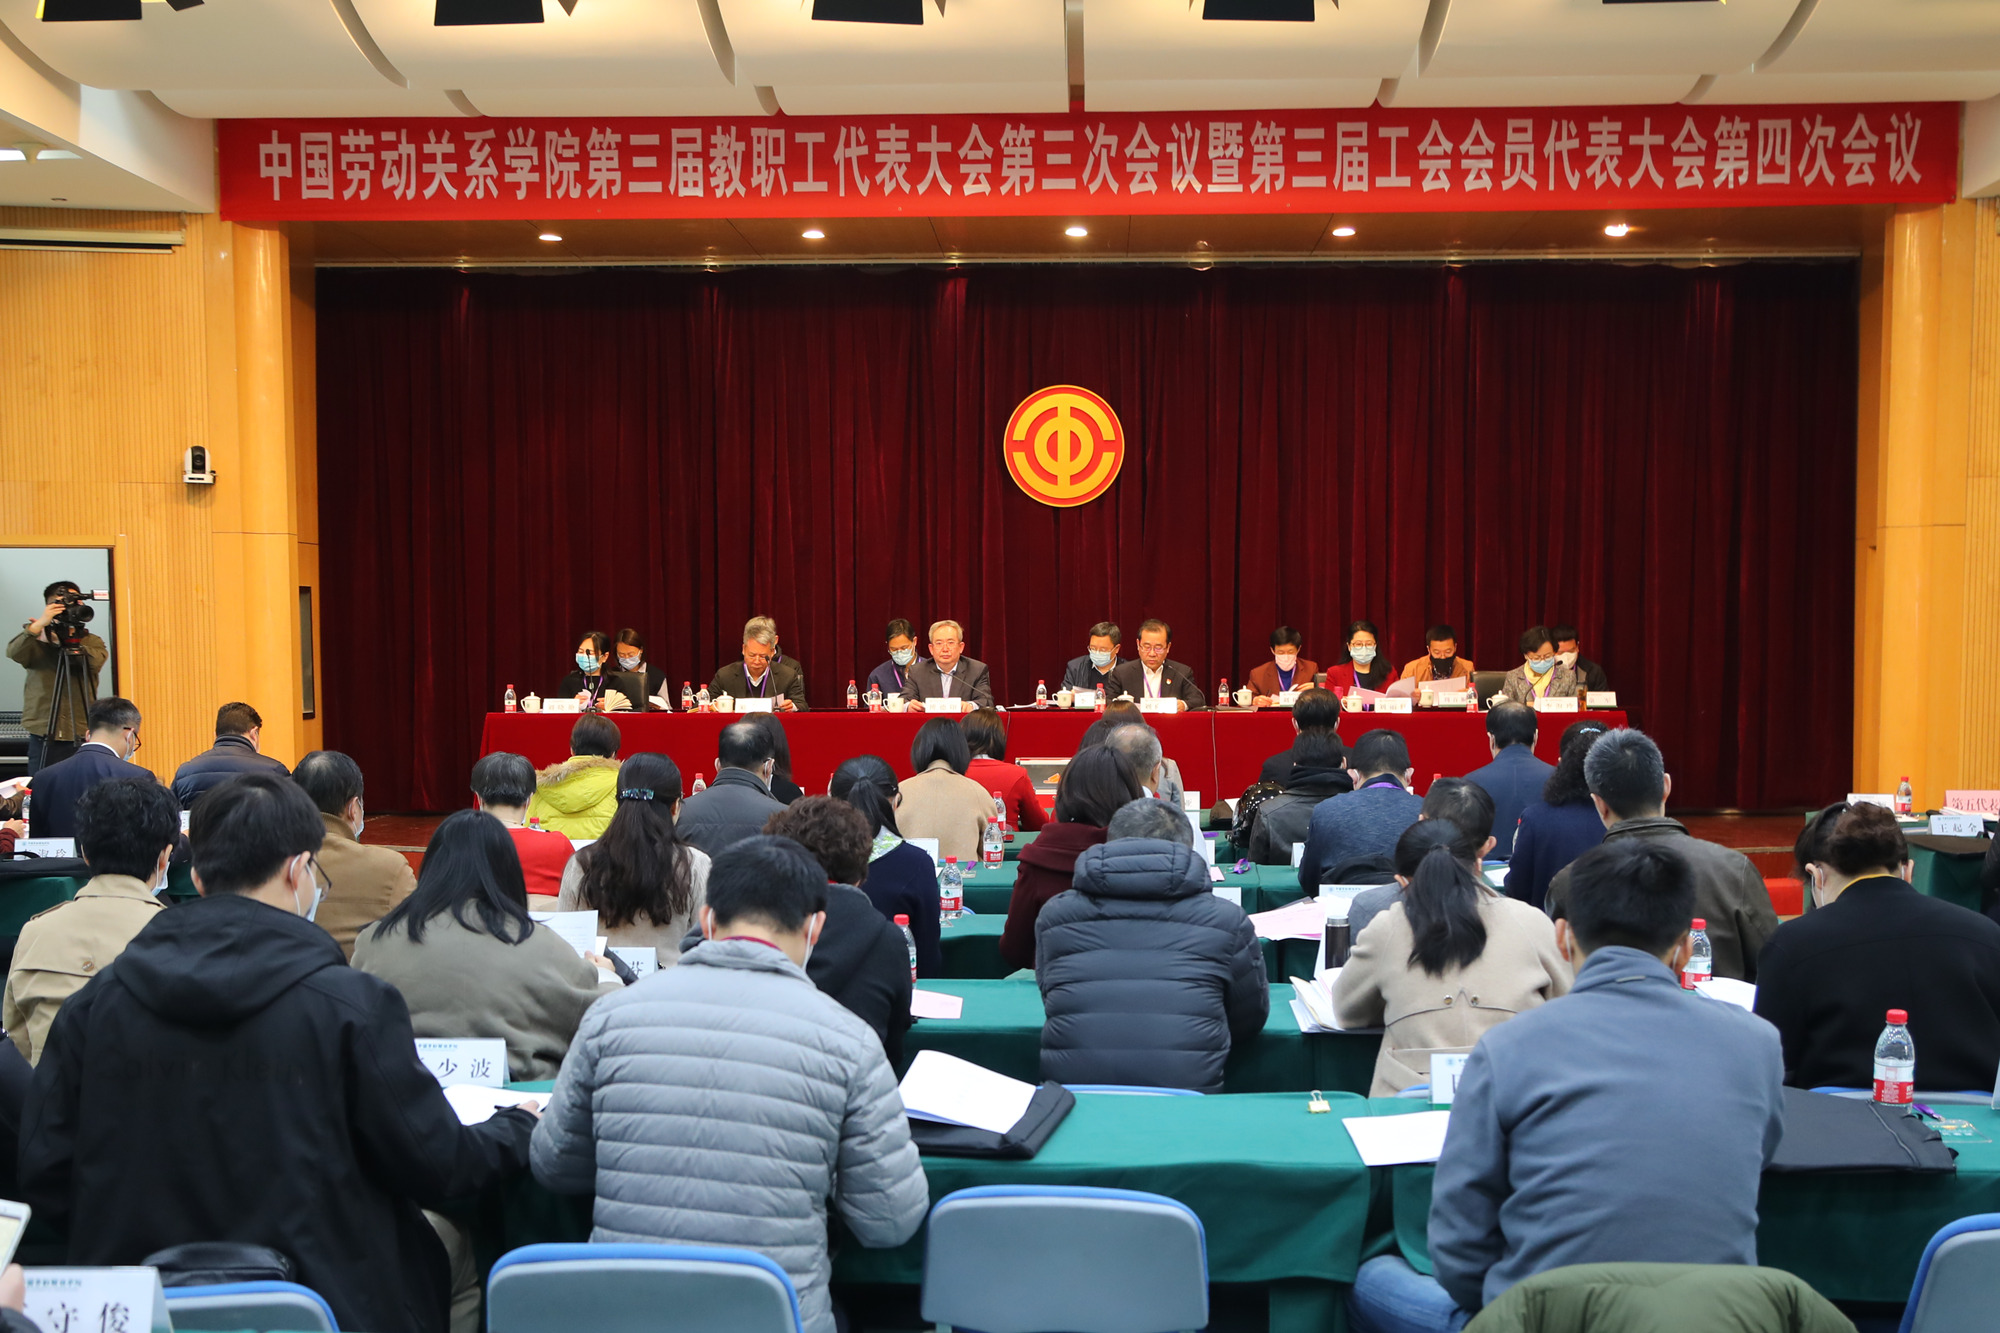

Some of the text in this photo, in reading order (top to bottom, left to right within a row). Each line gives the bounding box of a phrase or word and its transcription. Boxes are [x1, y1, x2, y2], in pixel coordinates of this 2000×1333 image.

[257, 111, 1923, 203] 中国劳动关系学院第三届教职工代表大会第三次会议暨第三届工会会员代表大会第四次会议
[420, 1057, 492, 1079] 少波
[23, 1301, 131, 1333] 守俊
